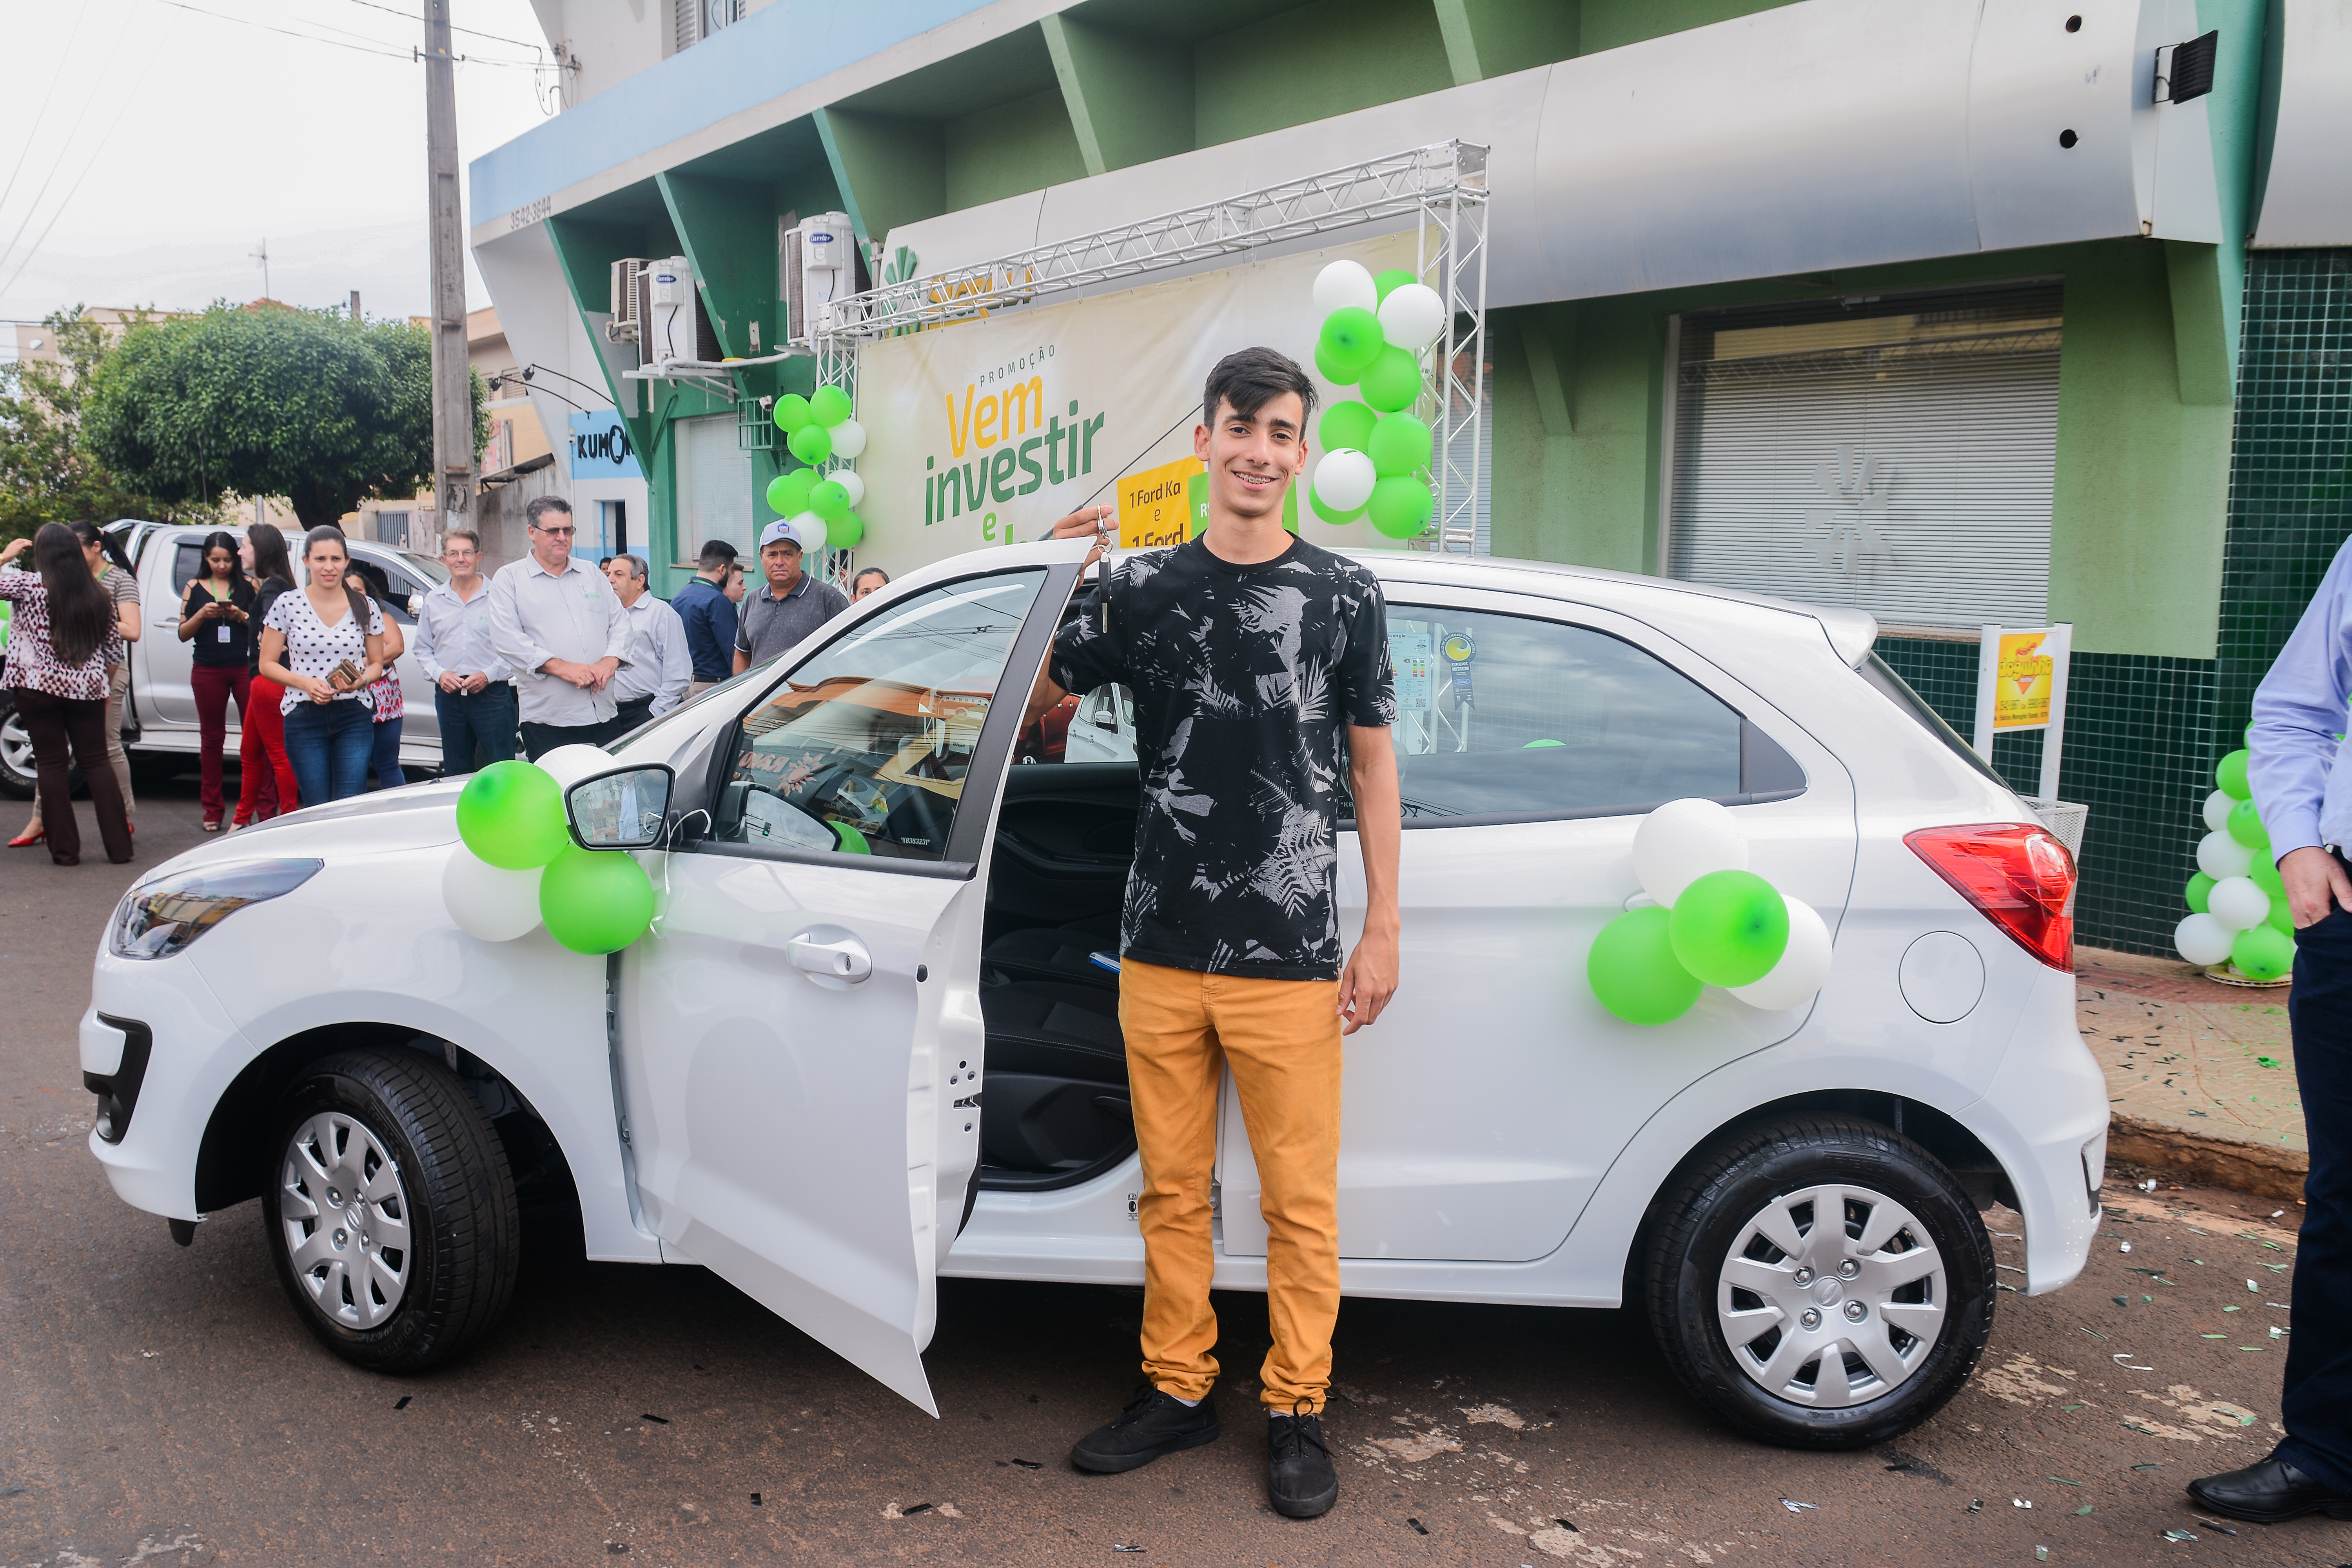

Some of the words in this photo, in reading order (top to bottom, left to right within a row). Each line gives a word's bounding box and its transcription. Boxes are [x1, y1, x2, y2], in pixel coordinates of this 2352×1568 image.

[980, 344, 1055, 387] PROMOÇÃO
[945, 375, 1043, 459] Vem
[925, 399, 1105, 526] investir
[1129, 492, 1134, 508] 1
[1137, 483, 1162, 506] Ford
[1165, 479, 1181, 498] Ka
[983, 512, 996, 541] e
[1154, 508, 1161, 521] e
[1132, 535, 1140, 547] 1
[1144, 523, 1184, 547] Ford
[1998, 656, 2053, 681] doguinho
